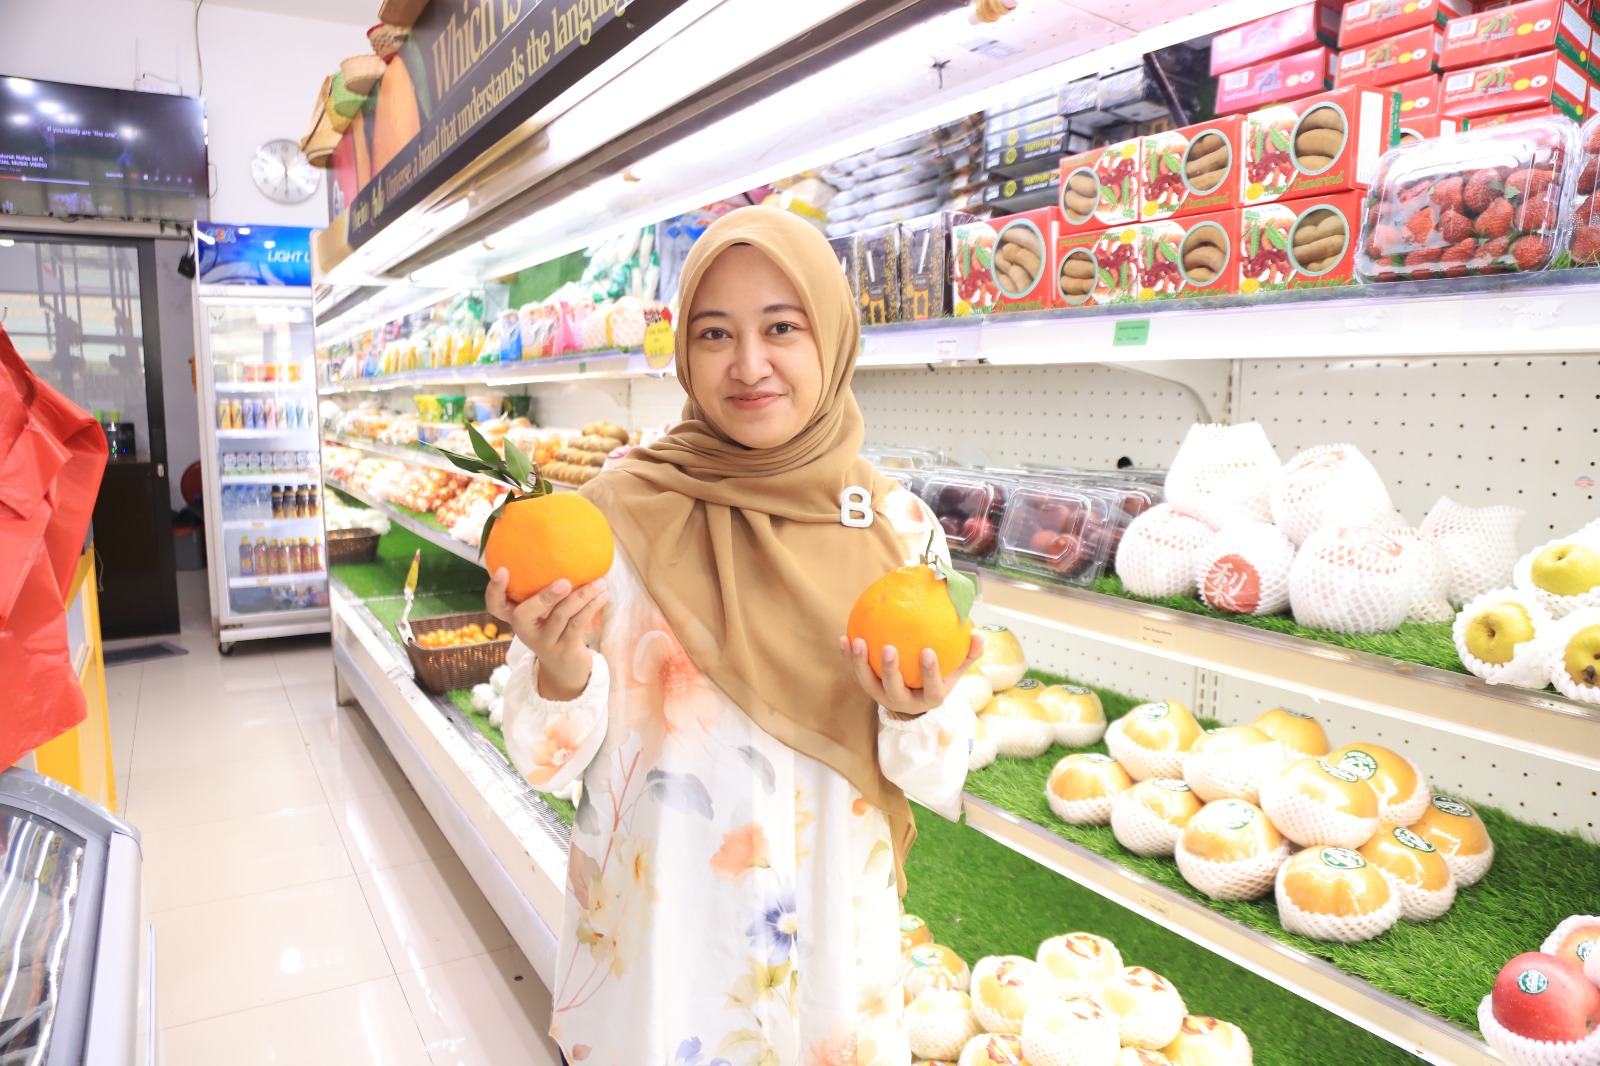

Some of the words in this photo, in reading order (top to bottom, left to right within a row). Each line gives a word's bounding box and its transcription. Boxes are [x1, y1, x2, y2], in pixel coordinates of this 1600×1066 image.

[418, 125, 440, 173] brand
[440, 112, 457, 153] that
[457, 46, 525, 137] understands
[526, 28, 551, 76] the
[552, 0, 626, 55] langu
[1292, 170, 1344, 192] Tamarind
[267, 250, 302, 263] LIGHT
[840, 485, 874, 528] B
